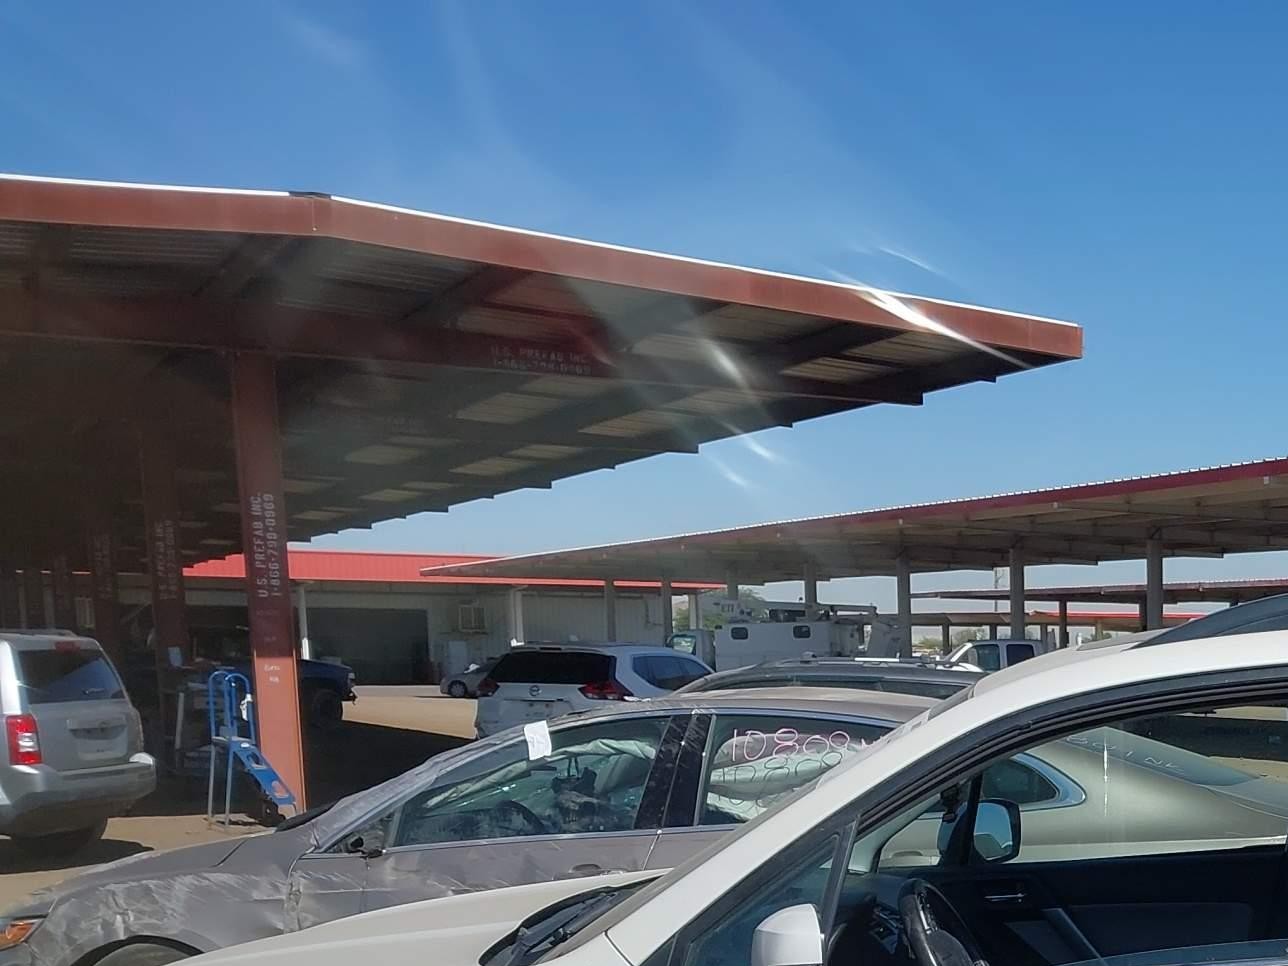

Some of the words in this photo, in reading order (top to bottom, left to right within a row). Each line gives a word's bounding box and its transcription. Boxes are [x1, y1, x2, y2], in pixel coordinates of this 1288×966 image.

[250, 492, 263, 516] INC.
[252, 520, 267, 569] PREFAB
[257, 575, 269, 598] U.S.
